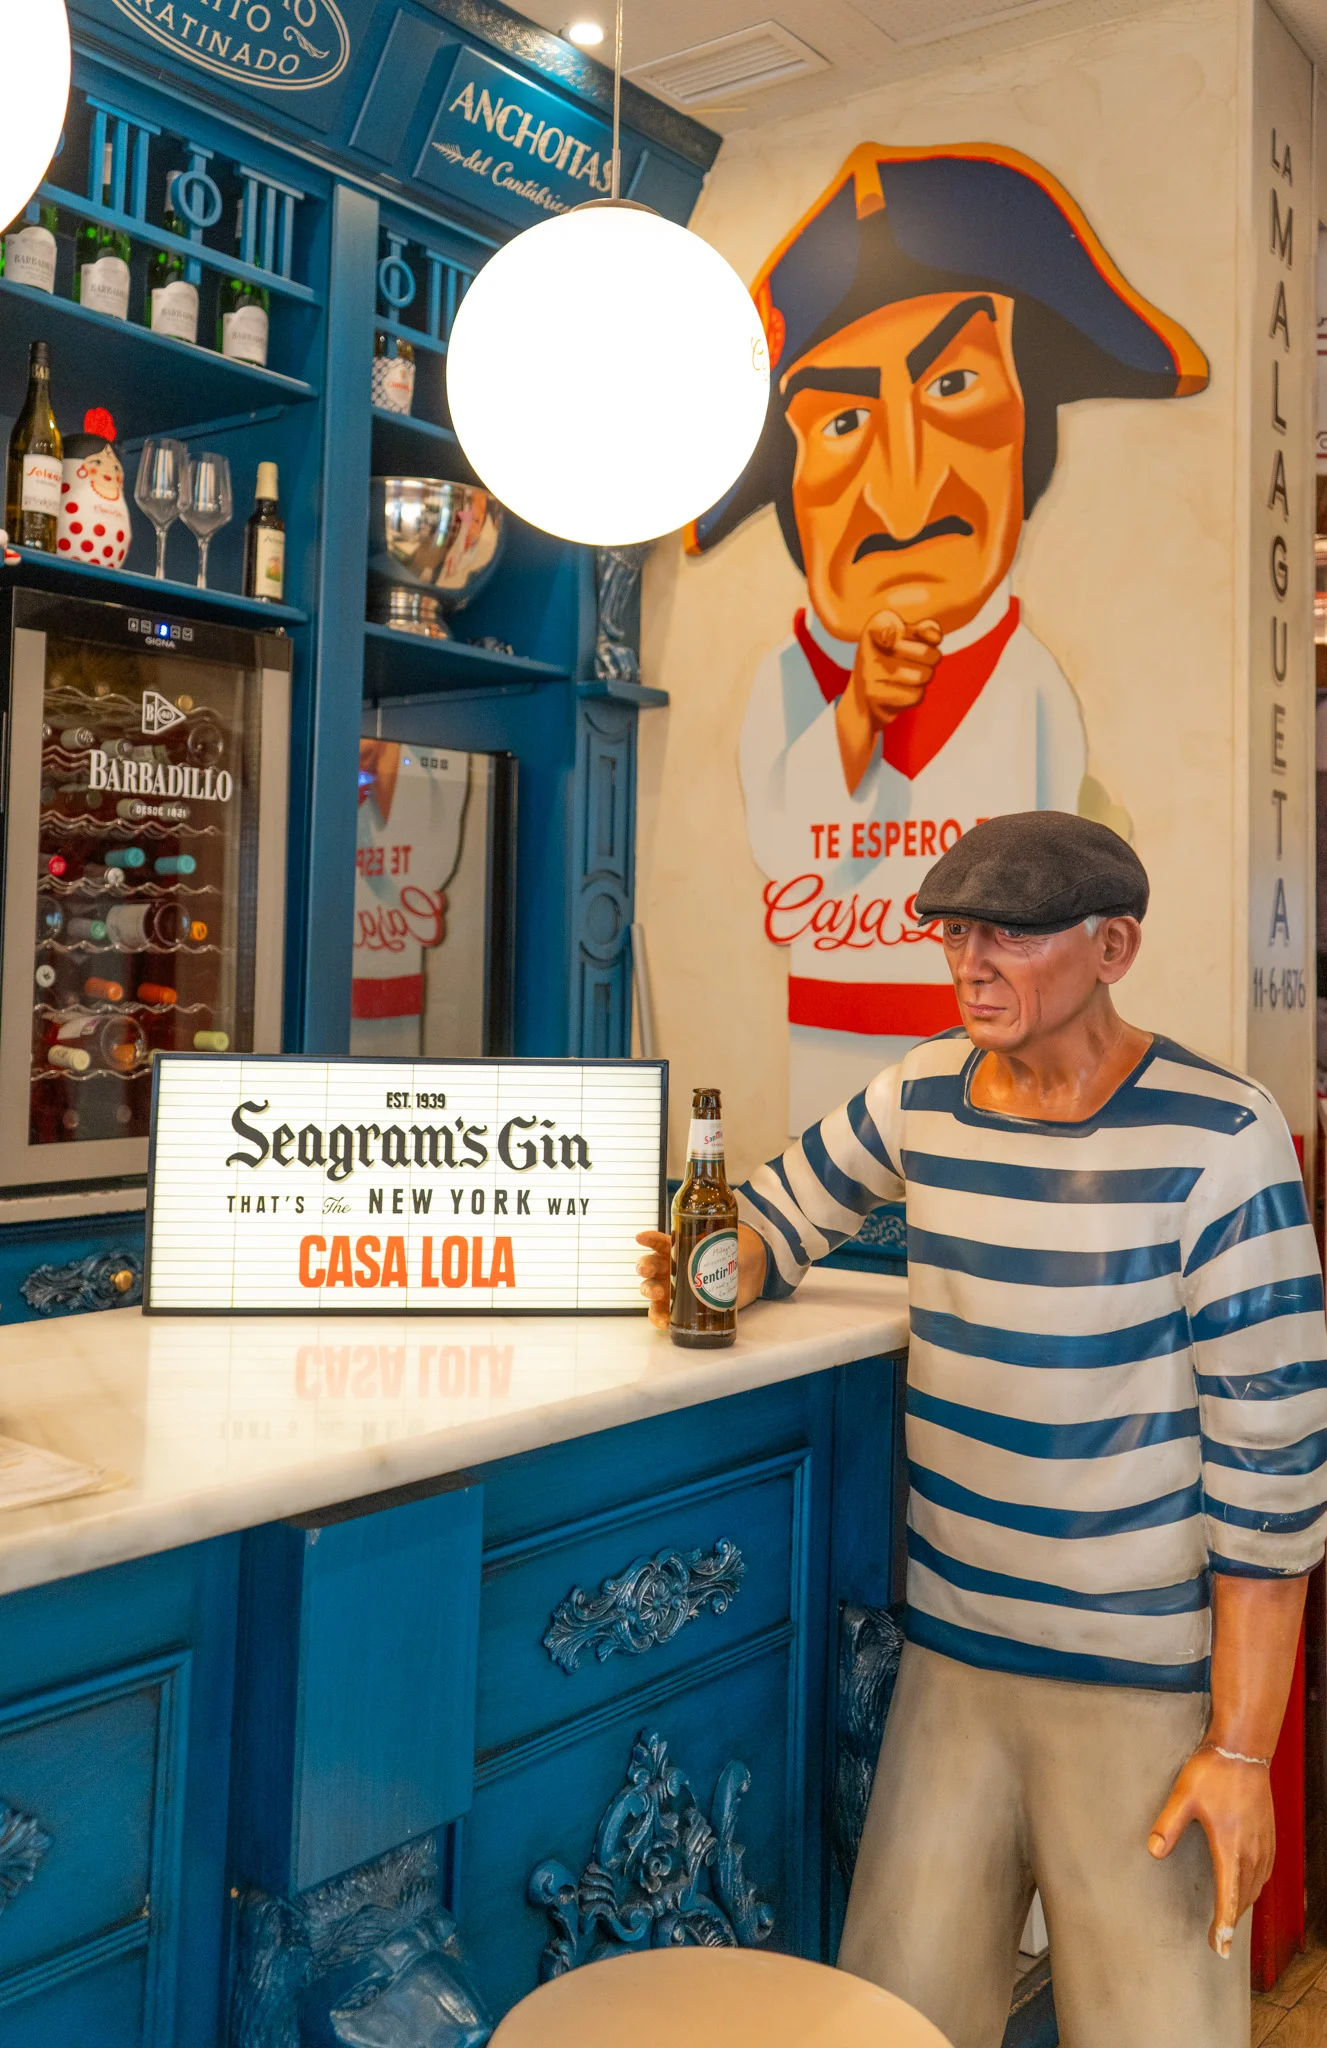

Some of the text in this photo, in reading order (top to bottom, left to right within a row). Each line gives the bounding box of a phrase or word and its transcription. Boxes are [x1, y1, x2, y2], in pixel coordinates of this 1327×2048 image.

[449, 82, 613, 192] ANCHOITAS
[462, 149, 493, 176] del
[1270, 128, 1292, 184] LA
[88, 749, 233, 802] BARBADILLO
[135, 804, 187, 818] DESDE 1821
[811, 818, 963, 859] TE ESPERO
[763, 873, 902, 951] Casa
[386, 1092, 446, 1109] EST. 1939
[226, 1099, 593, 1182] Seagram's Gin
[226, 1188, 590, 1216] THAT'S The NEW YORK WAY
[299, 1234, 517, 1288] CASA LOLA
